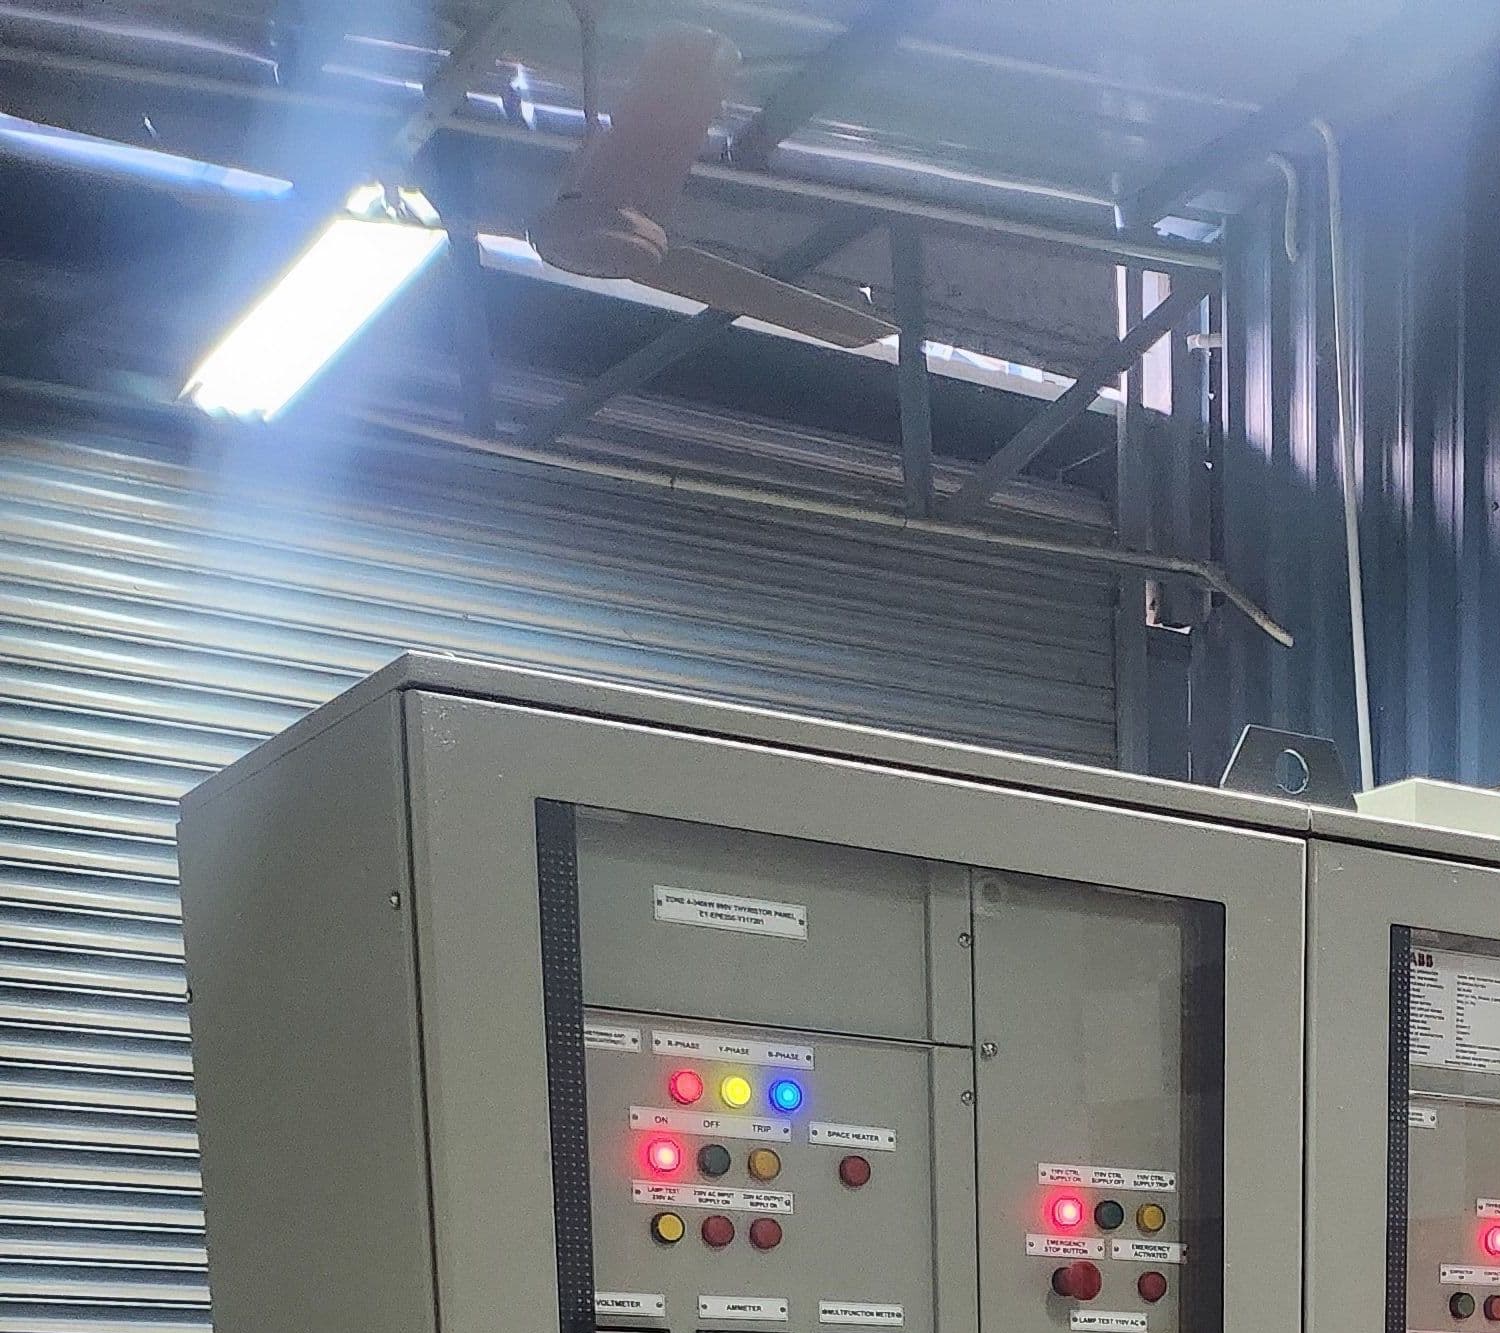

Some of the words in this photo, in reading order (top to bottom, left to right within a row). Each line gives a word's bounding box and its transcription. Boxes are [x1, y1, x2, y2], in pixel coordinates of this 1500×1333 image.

[667, 1039, 700, 1050] R-PHASE
[718, 1045, 750, 1056] Y-PHASE
[654, 1115, 668, 1125] ON
[703, 1119, 721, 1129] OFF
[752, 1124, 772, 1134] TRIP
[827, 1130, 851, 1140] SPACE
[852, 1132, 880, 1142] HEATER
[1046, 1239, 1087, 1248] EMERGENCY
[1131, 1243, 1171, 1253] EMERGENCY
[1062, 1247, 1089, 1255] BUTTON
[1133, 1250, 1168, 1259] ACTIVATED
[726, 1304, 762, 1313] AMMETER
[875, 1310, 897, 1319] METER
